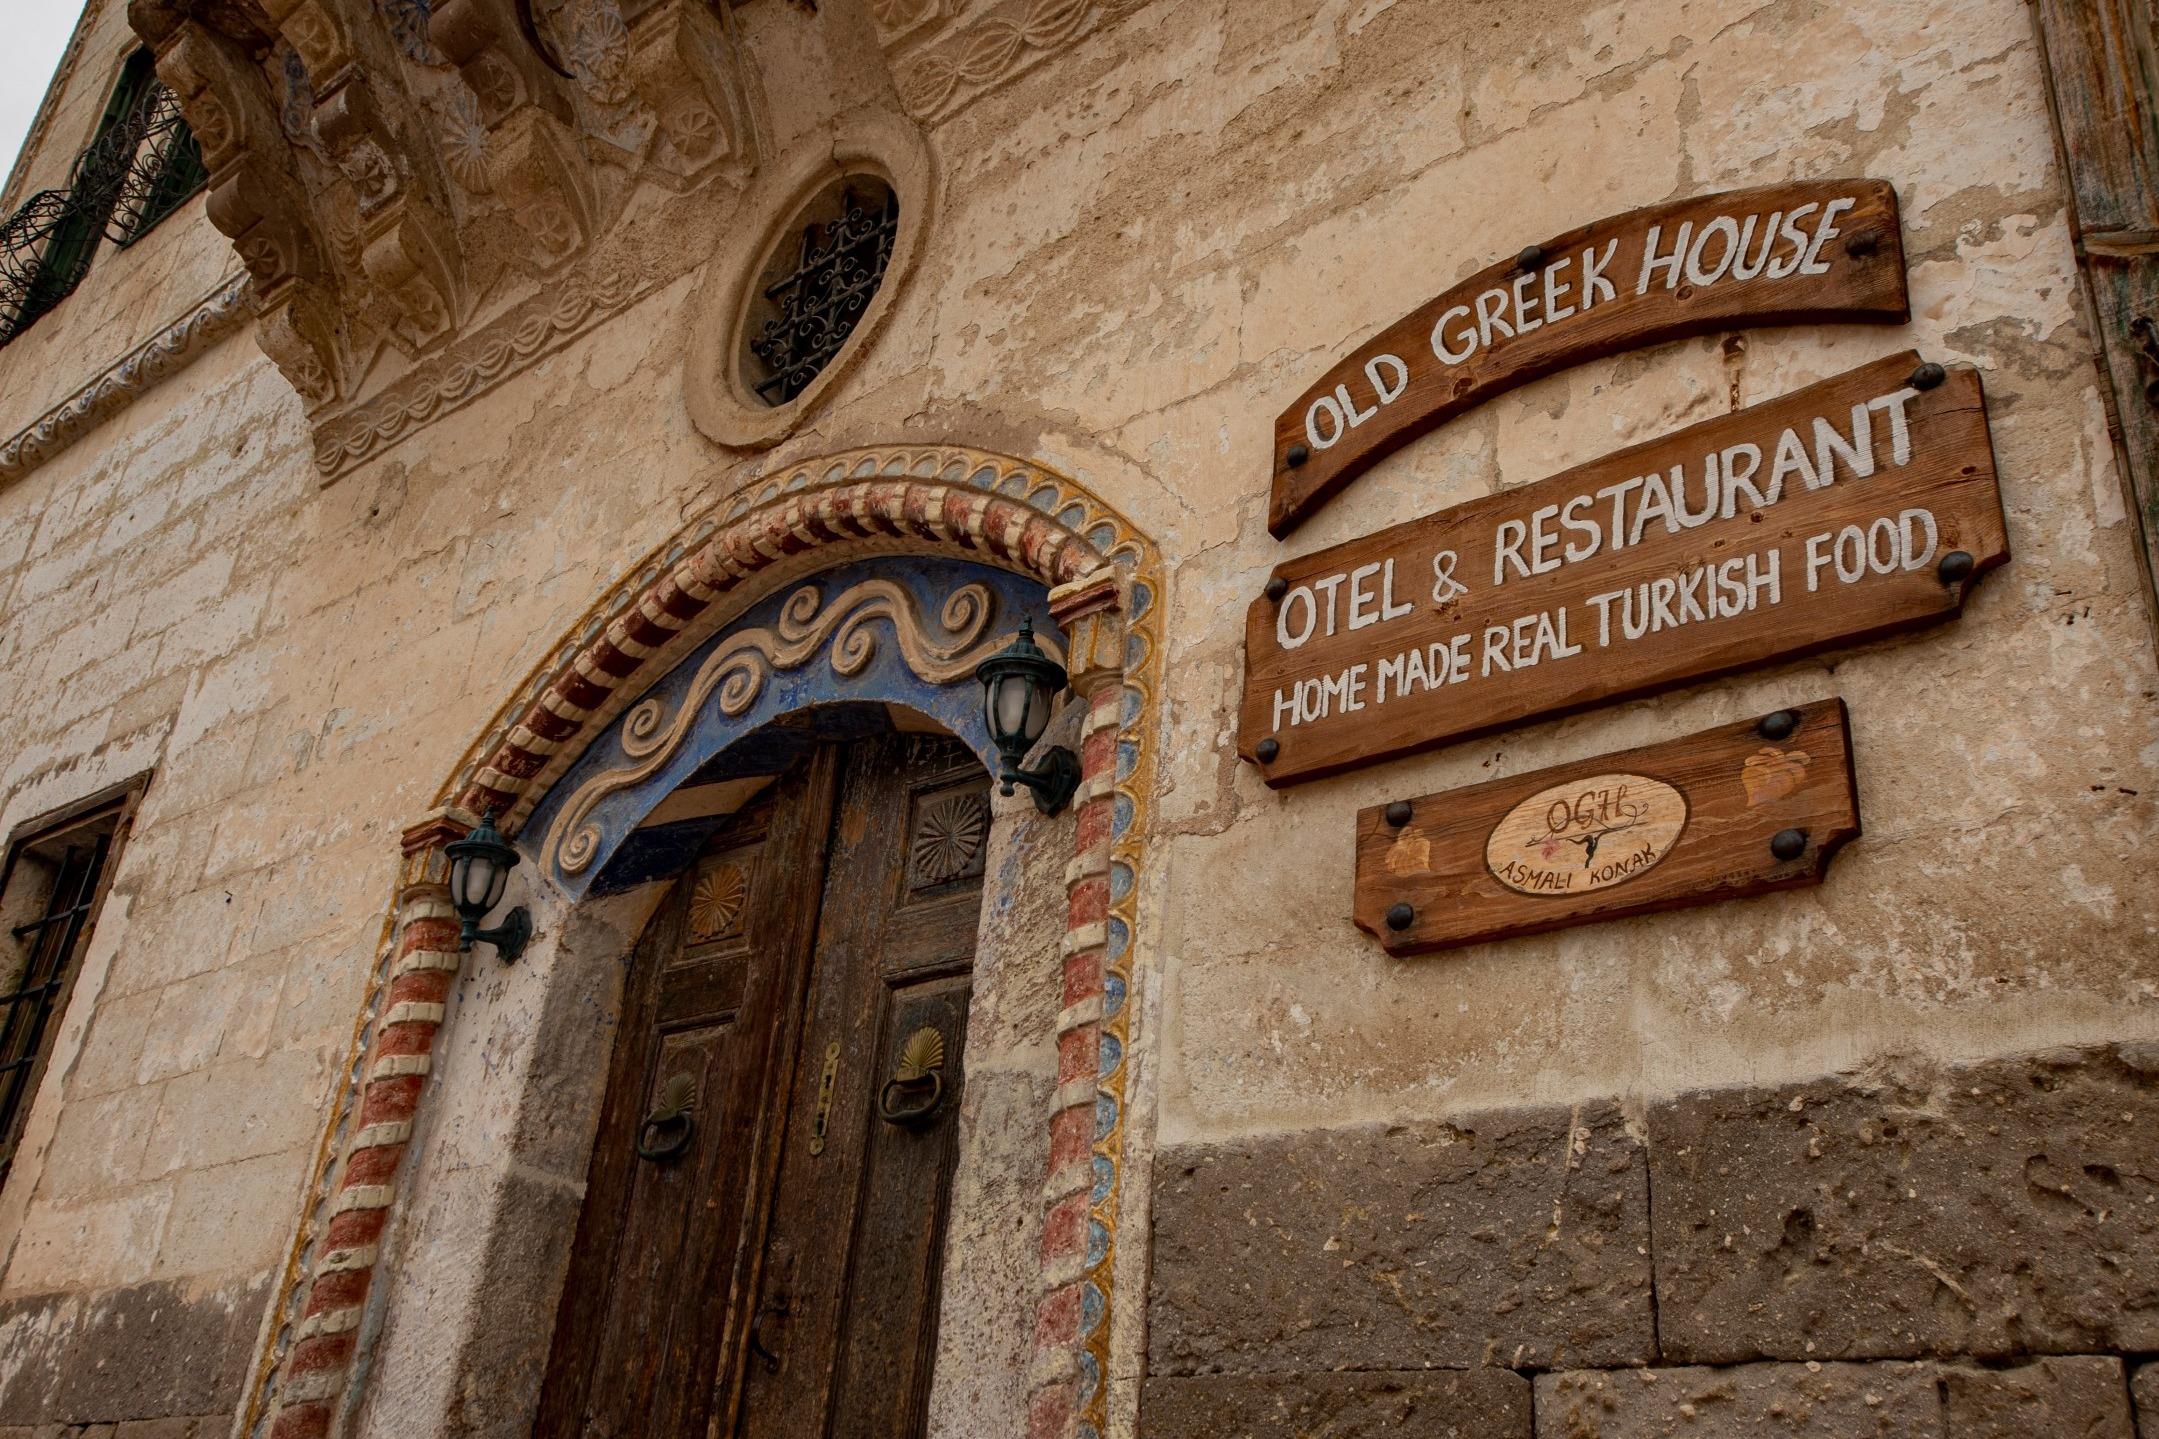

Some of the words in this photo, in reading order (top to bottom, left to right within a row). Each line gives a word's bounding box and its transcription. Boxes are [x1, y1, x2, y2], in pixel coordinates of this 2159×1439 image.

[1305, 353, 1410, 450] OLD
[1430, 238, 1620, 365] GREEK
[1636, 197, 1856, 296] HOUSE
[1272, 663, 1367, 732] HOME
[1376, 635, 1471, 704] MADE
[1481, 608, 1582, 678] REAL
[1587, 549, 1781, 648] TURKISH
[1806, 508, 1939, 592] FOOD
[1275, 558, 1414, 650] OTEL
[1432, 550, 1469, 603] &
[1494, 386, 1921, 586] RESTAURANT
[1500, 860, 1572, 890] ASMALI
[1589, 842, 1657, 886] KONAK
